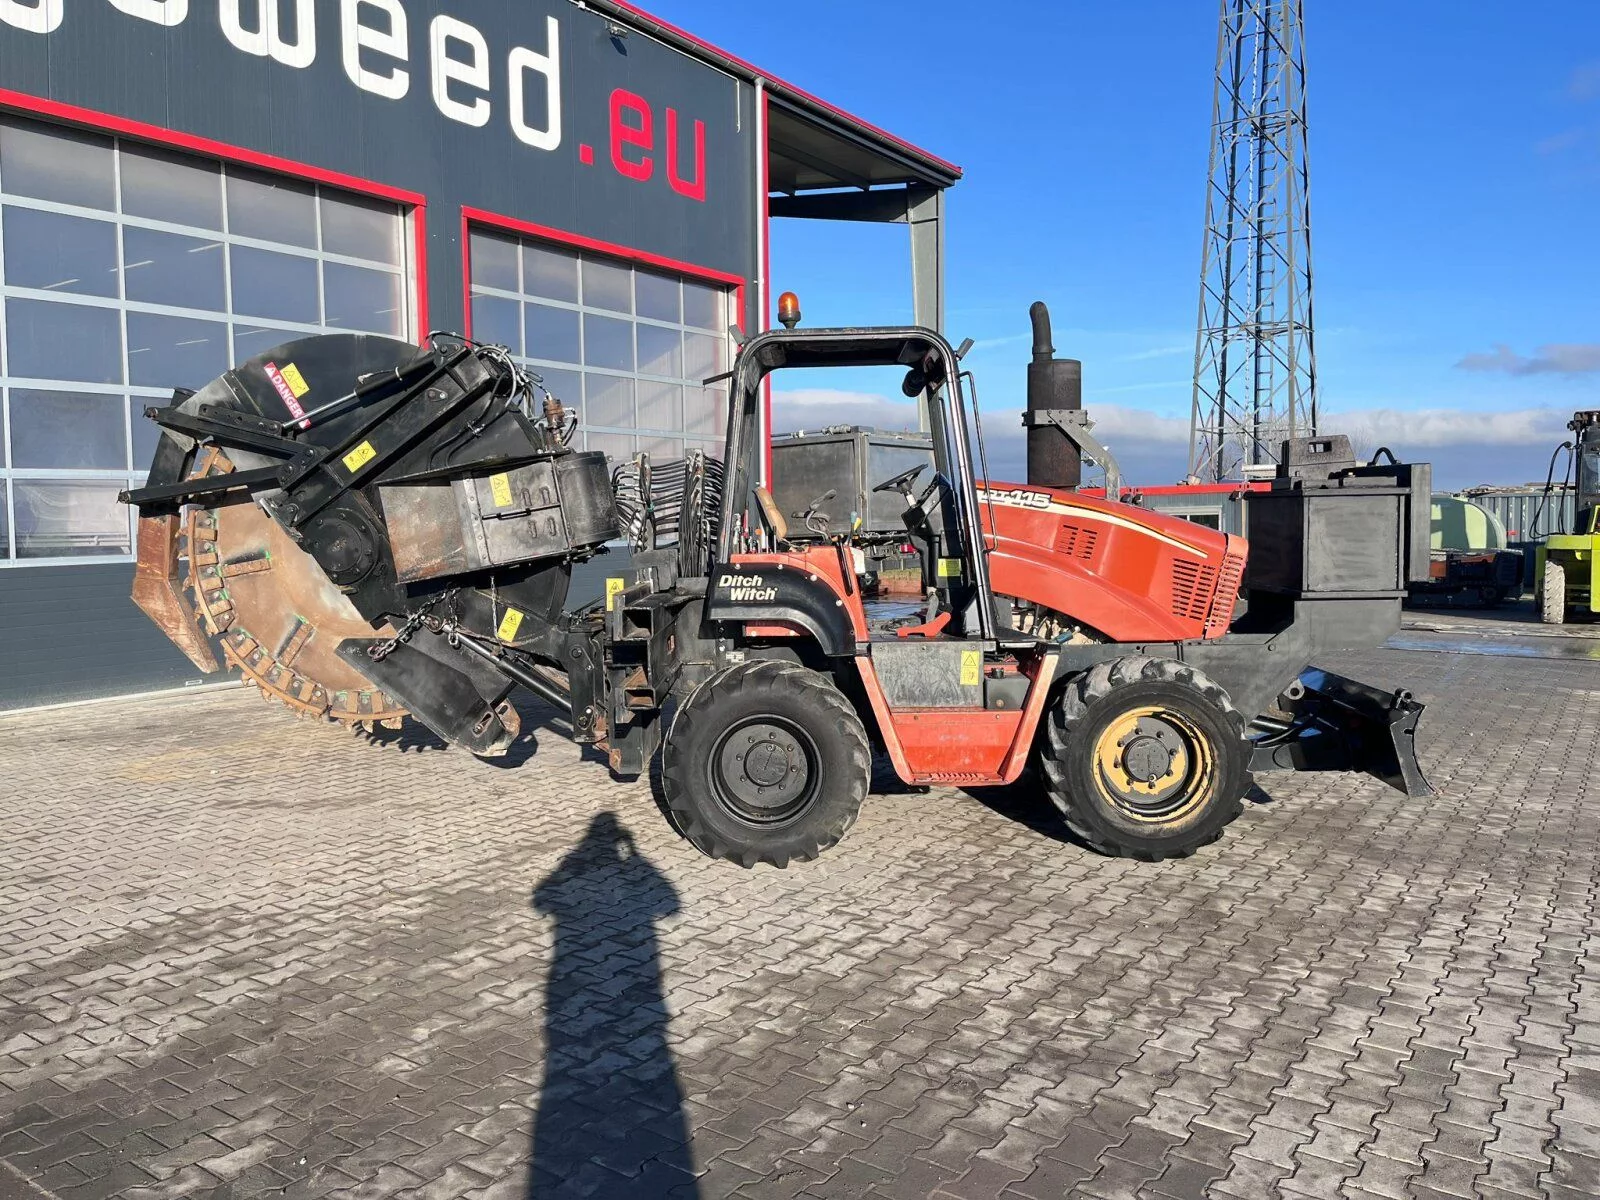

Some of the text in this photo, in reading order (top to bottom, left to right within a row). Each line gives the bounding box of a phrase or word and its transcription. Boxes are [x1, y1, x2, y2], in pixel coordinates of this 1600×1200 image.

[272, 375, 305, 419] DANGER
[719, 574, 763, 587] Ditch
[730, 587, 777, 601] Witch
